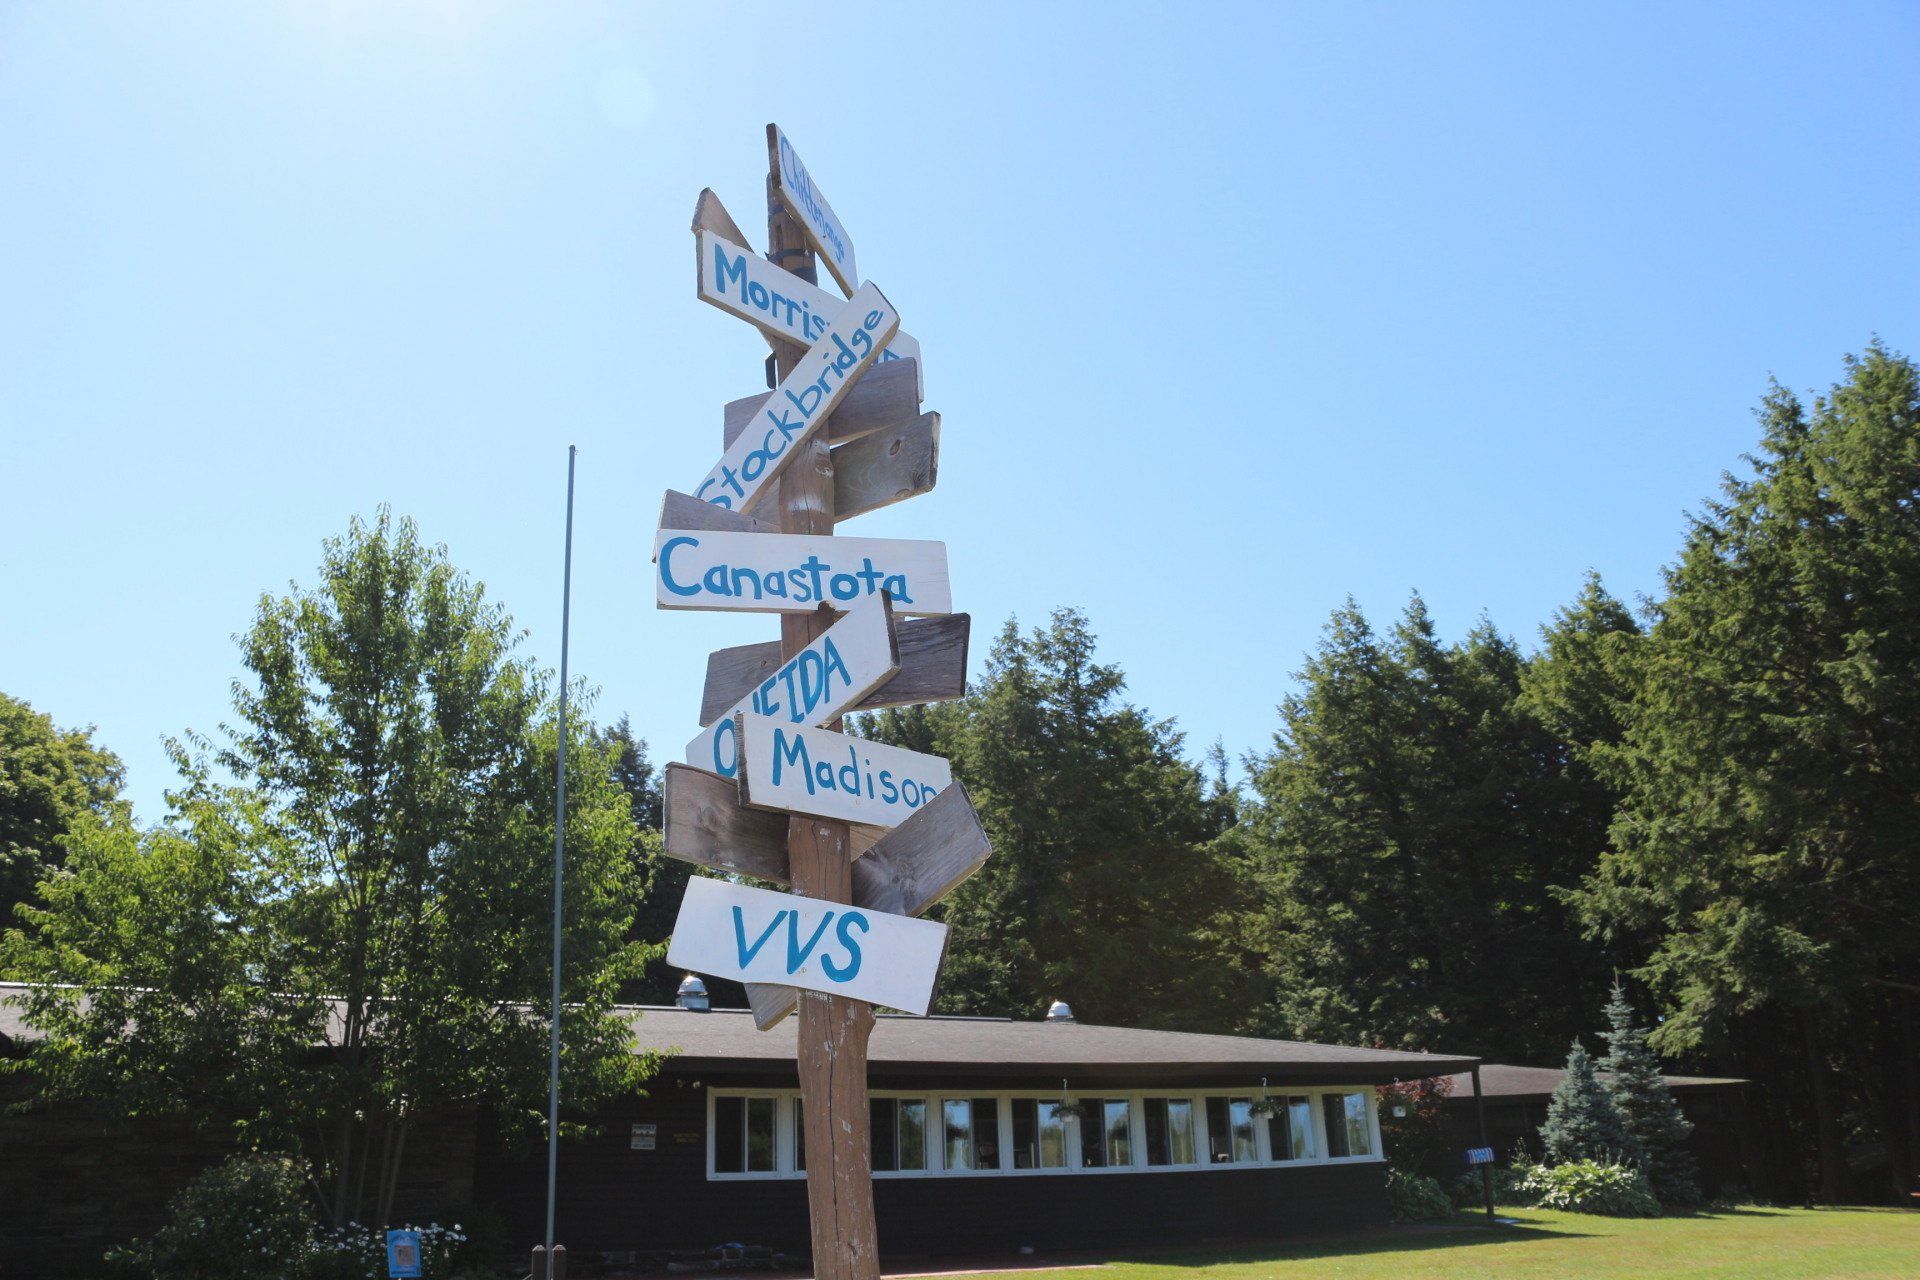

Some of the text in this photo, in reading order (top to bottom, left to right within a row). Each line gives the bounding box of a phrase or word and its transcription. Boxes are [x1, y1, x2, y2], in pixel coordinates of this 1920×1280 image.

[714, 242, 826, 341] Morris
[697, 309, 884, 509] Stockbridge
[659, 536, 913, 604] Canastota
[772, 728, 938, 808] Madison
[732, 905, 869, 982] VVS
